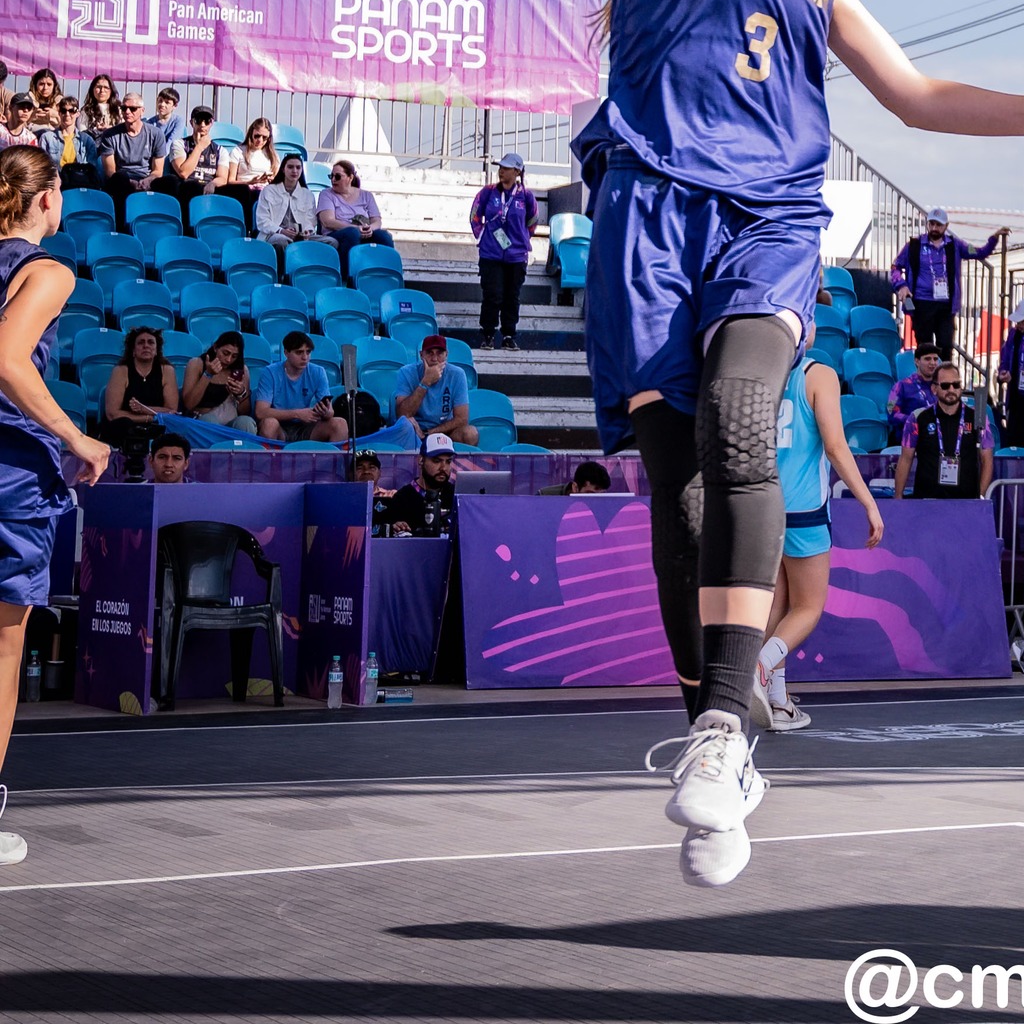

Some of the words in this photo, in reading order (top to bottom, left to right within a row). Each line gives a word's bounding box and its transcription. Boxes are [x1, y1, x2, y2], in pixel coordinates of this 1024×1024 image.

[168, 0, 194, 19] Pan
[197, 3, 263, 25] American
[167, 21, 215, 41] Games
[331, 24, 487, 69] SPORTS
[734, 11, 779, 83] 3
[442, 386, 451, 414] ARG
[95, 600, 102, 613] EL
[102, 598, 130, 616] CORAZÓN
[334, 596, 353, 611] PANAM
[91, 618, 99, 631] EN
[99, 619, 110, 633] LOS
[110, 620, 132, 636] JUEGOS
[333, 610, 353, 626] SPORTS
